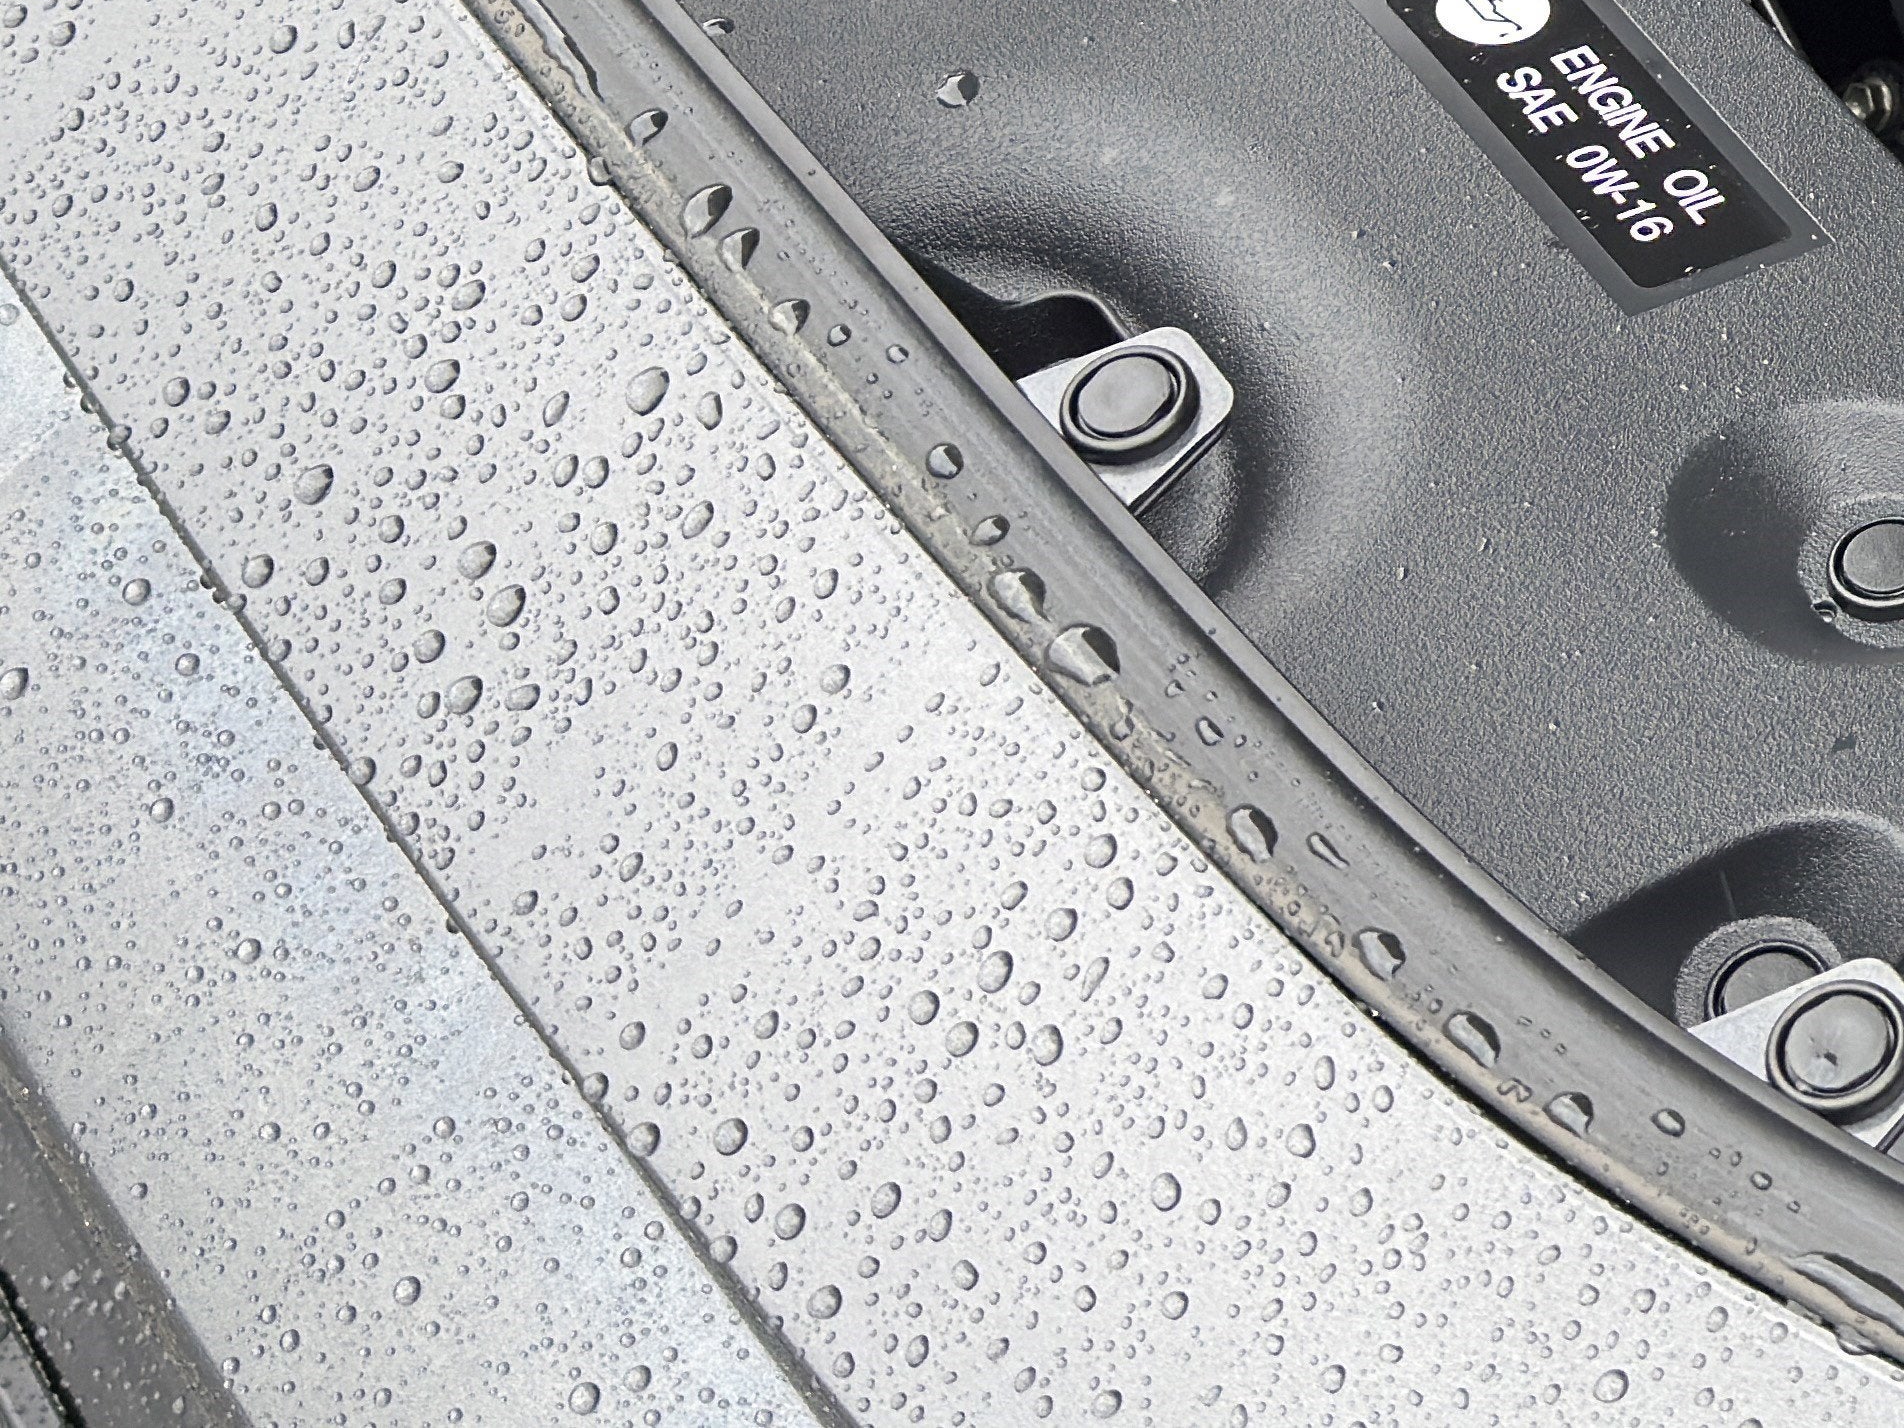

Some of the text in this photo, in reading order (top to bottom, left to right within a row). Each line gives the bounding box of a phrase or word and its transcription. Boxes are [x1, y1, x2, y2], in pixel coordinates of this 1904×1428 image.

[1496, 65, 1675, 242] SAE 0W-16
[1550, 44, 1726, 227] ENGINE OIL
